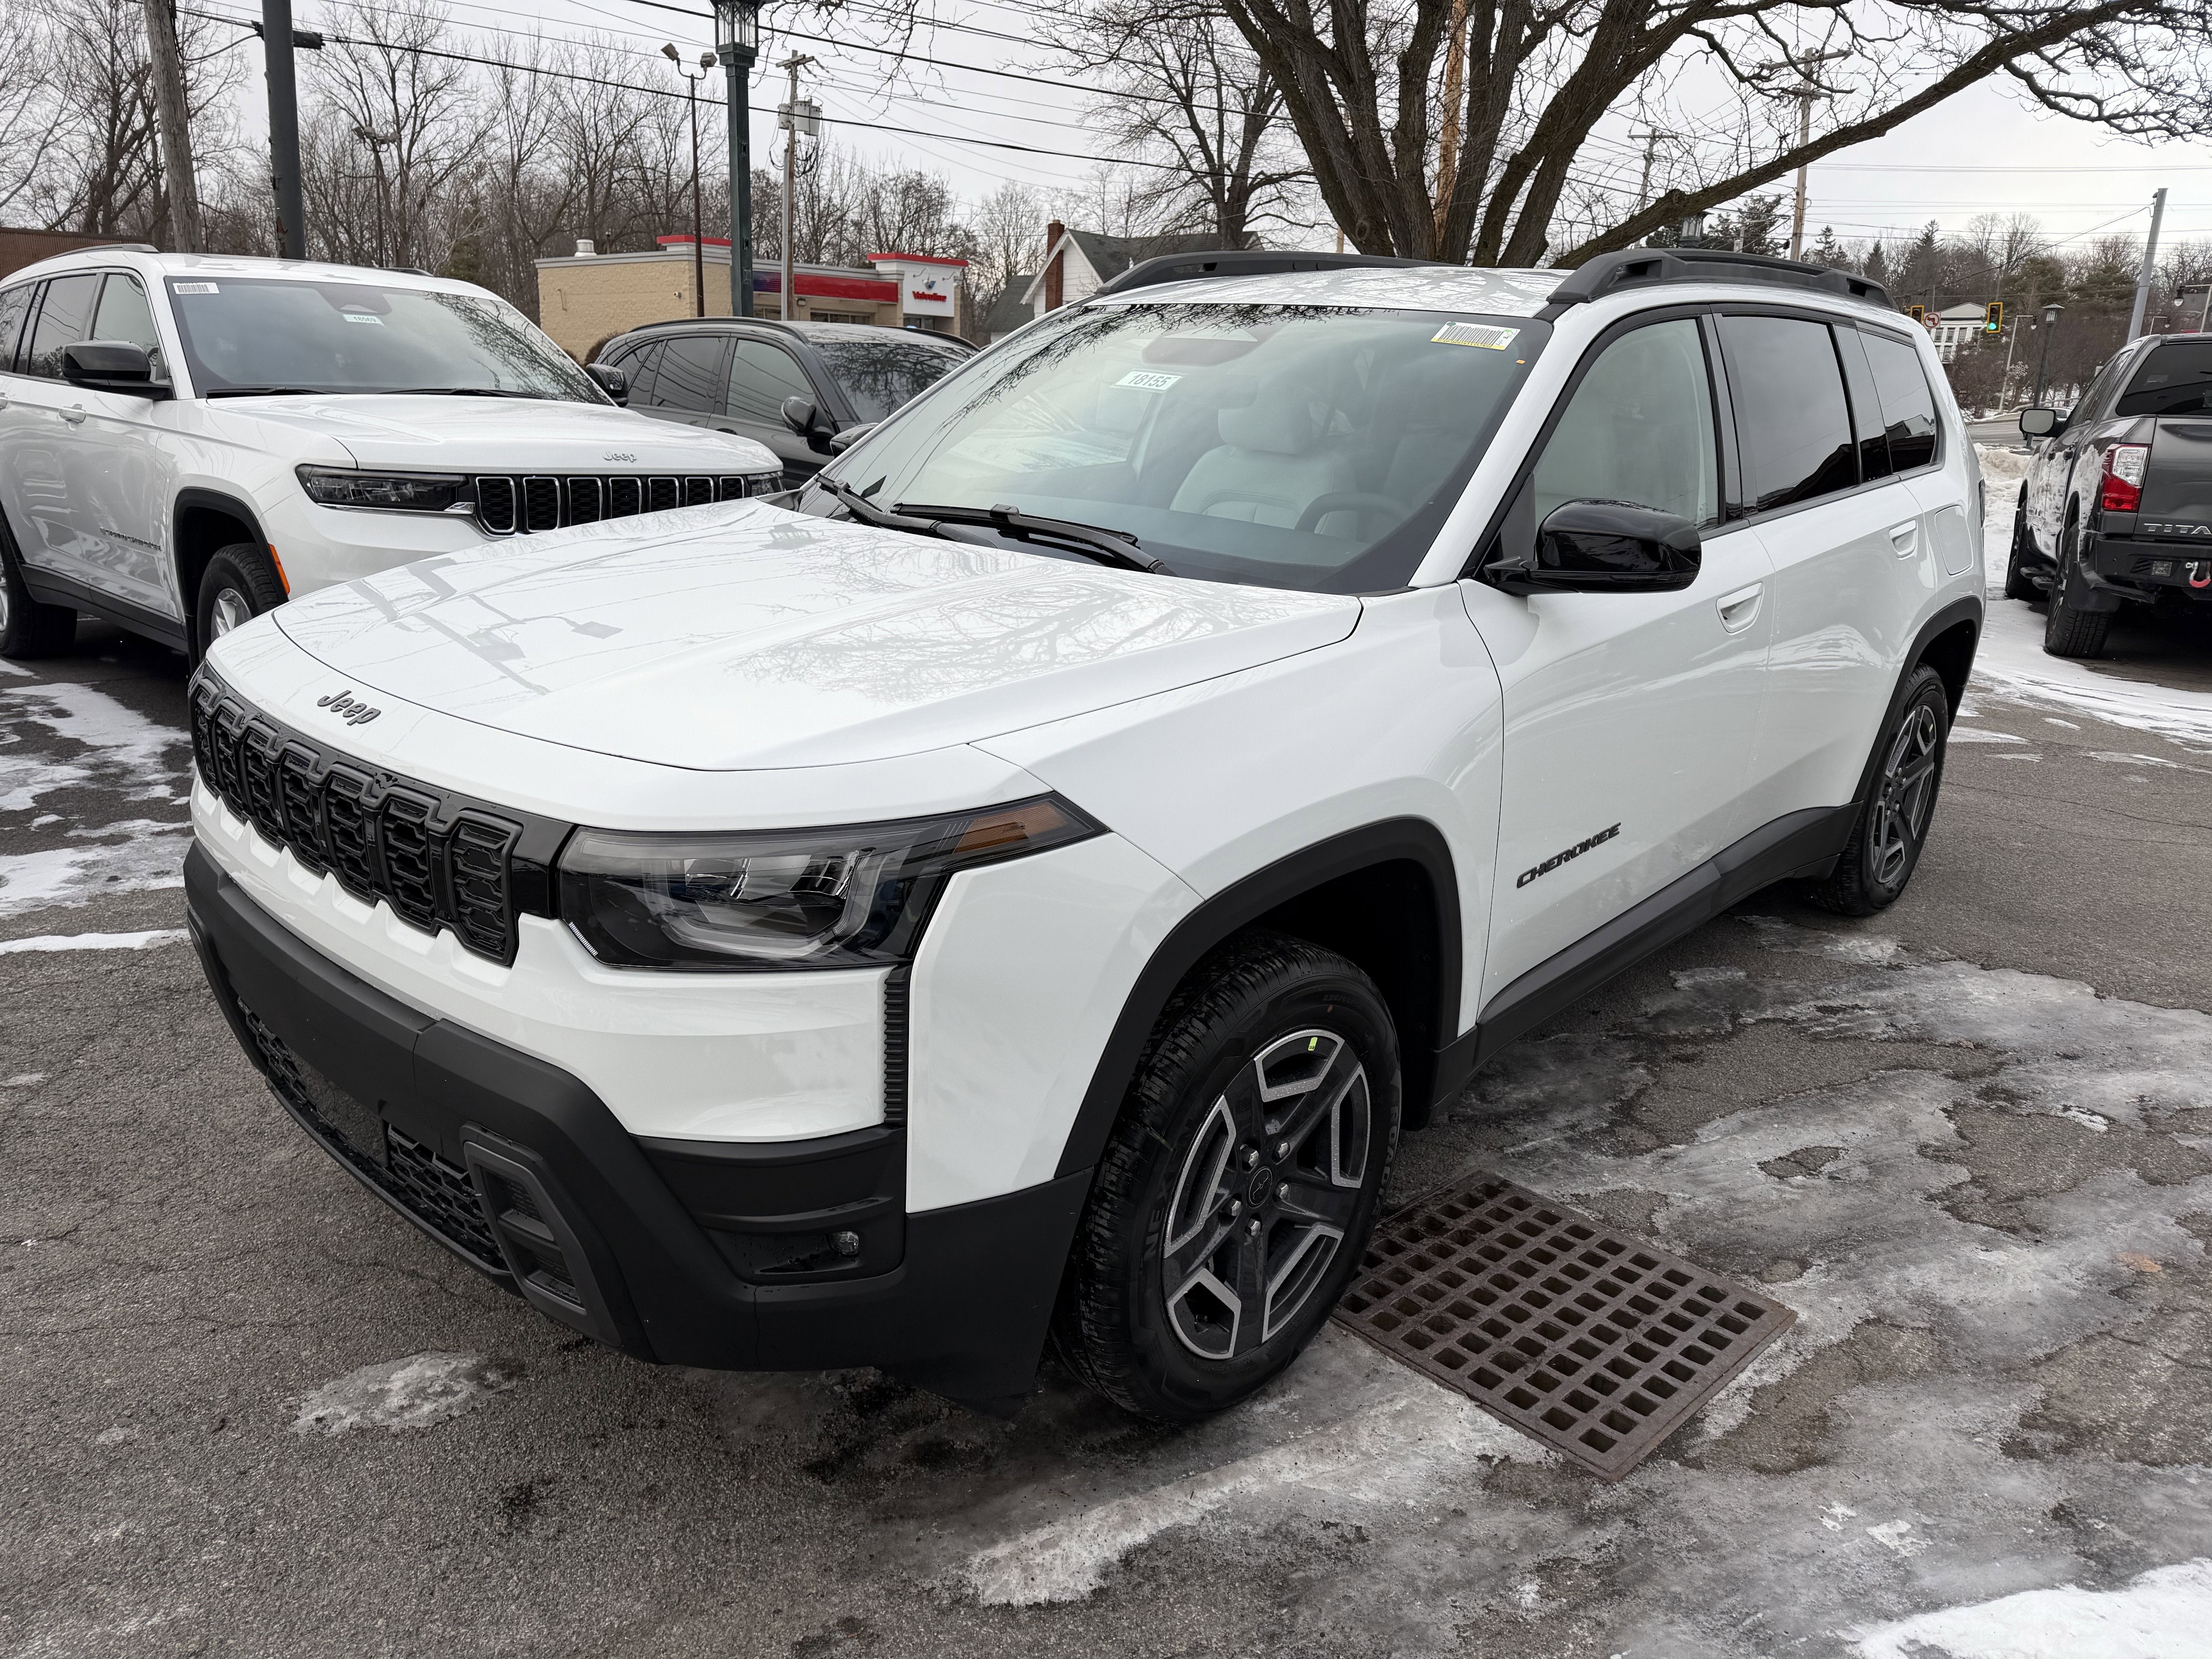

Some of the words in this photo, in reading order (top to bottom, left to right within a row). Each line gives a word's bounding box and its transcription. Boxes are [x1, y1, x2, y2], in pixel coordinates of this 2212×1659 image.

[912, 291, 946, 302] Valvoline
[1128, 373, 1172, 387] 18155
[603, 452, 636, 463] Jeep
[317, 690, 381, 726] Jeep
[1516, 822, 1621, 888] CHEROKEE
